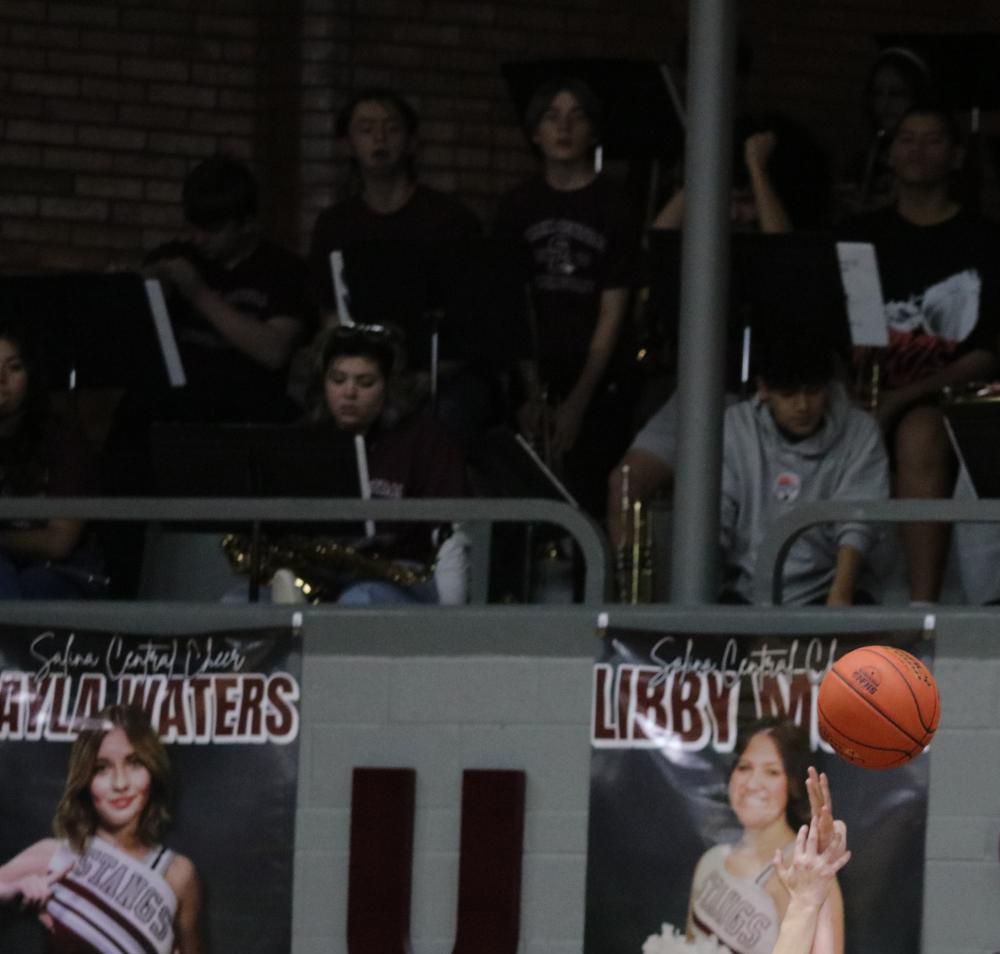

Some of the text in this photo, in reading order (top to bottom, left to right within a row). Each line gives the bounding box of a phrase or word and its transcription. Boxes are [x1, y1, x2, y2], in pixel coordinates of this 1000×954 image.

[106, 635, 176, 682] Central
[119, 671, 299, 744] WATERS
[590, 662, 738, 753] LIBBY
[74, 849, 173, 942] STANGS
